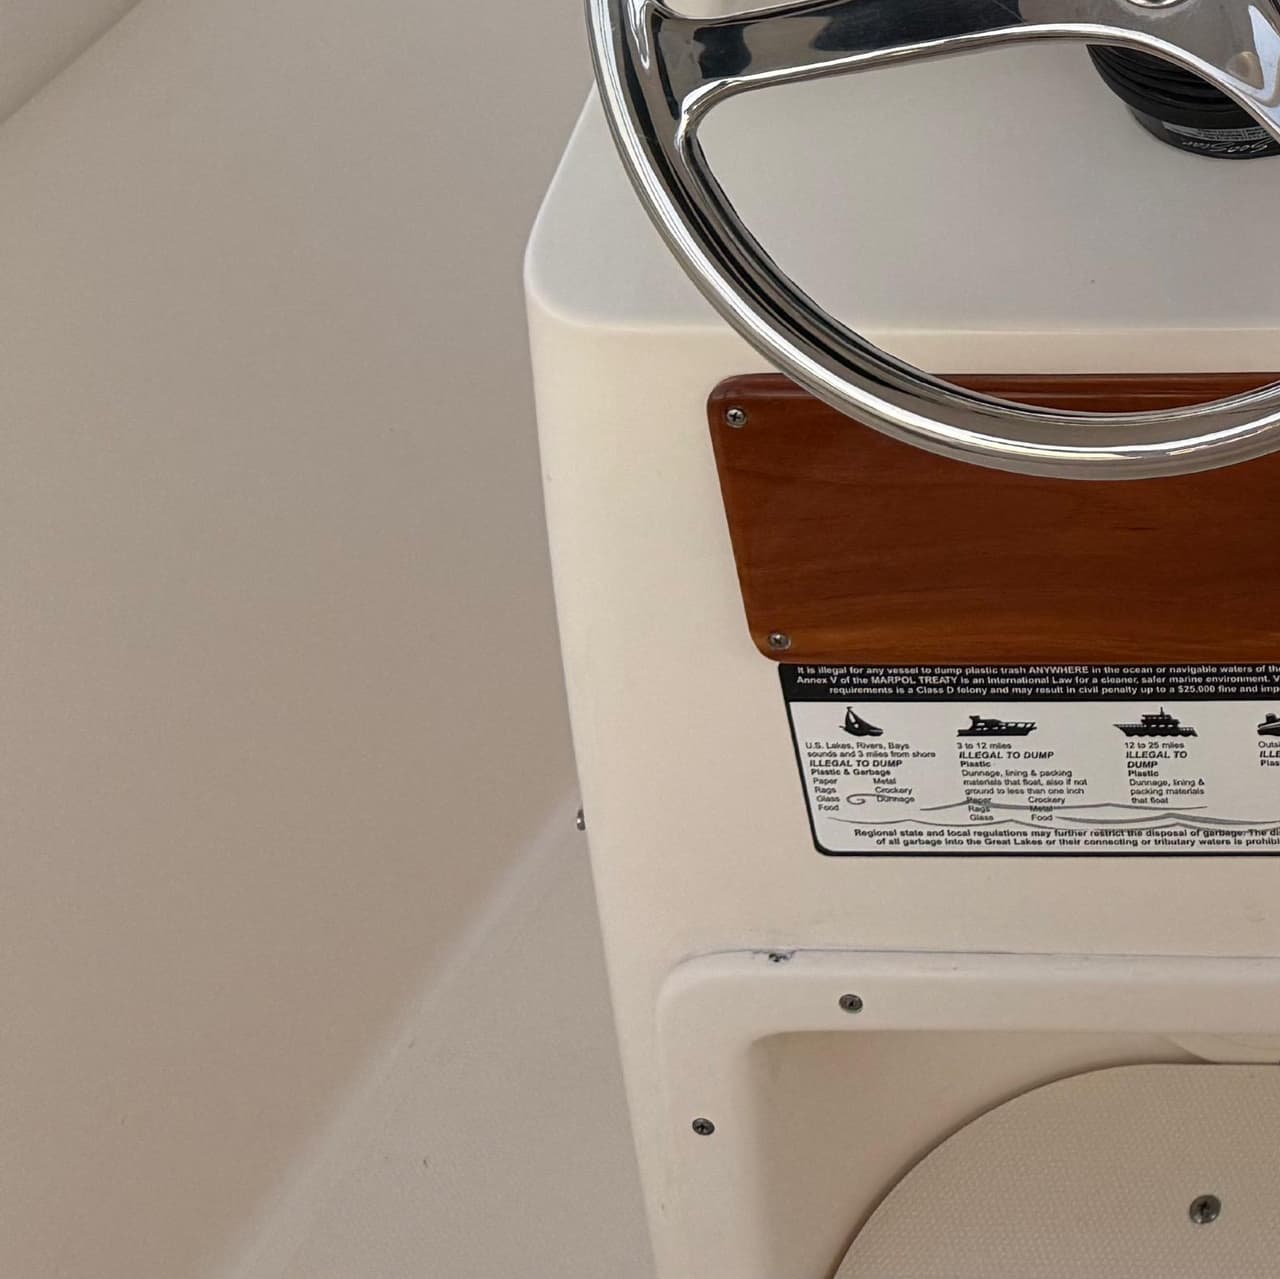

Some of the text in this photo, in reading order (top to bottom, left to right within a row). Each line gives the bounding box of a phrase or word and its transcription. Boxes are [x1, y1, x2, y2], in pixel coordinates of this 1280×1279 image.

[797, 667, 805, 675] It
[806, 667, 816, 675] is
[817, 667, 848, 677] illegal
[849, 667, 863, 675] for
[866, 668, 885, 676] any
[886, 666, 919, 675] vessel
[920, 667, 932, 675] to
[934, 666, 963, 676] dump
[964, 666, 999, 676] plastic
[1000, 666, 1027, 674] trash
[1028, 666, 1089, 674] ANYWHERE
[1091, 666, 1102, 674] in
[1103, 666, 1120, 674] the
[1169, 665, 1218, 675] navigable
[1255, 665, 1266, 673] of
[809, 759, 903, 768] ILLEGAL TO DUMP
